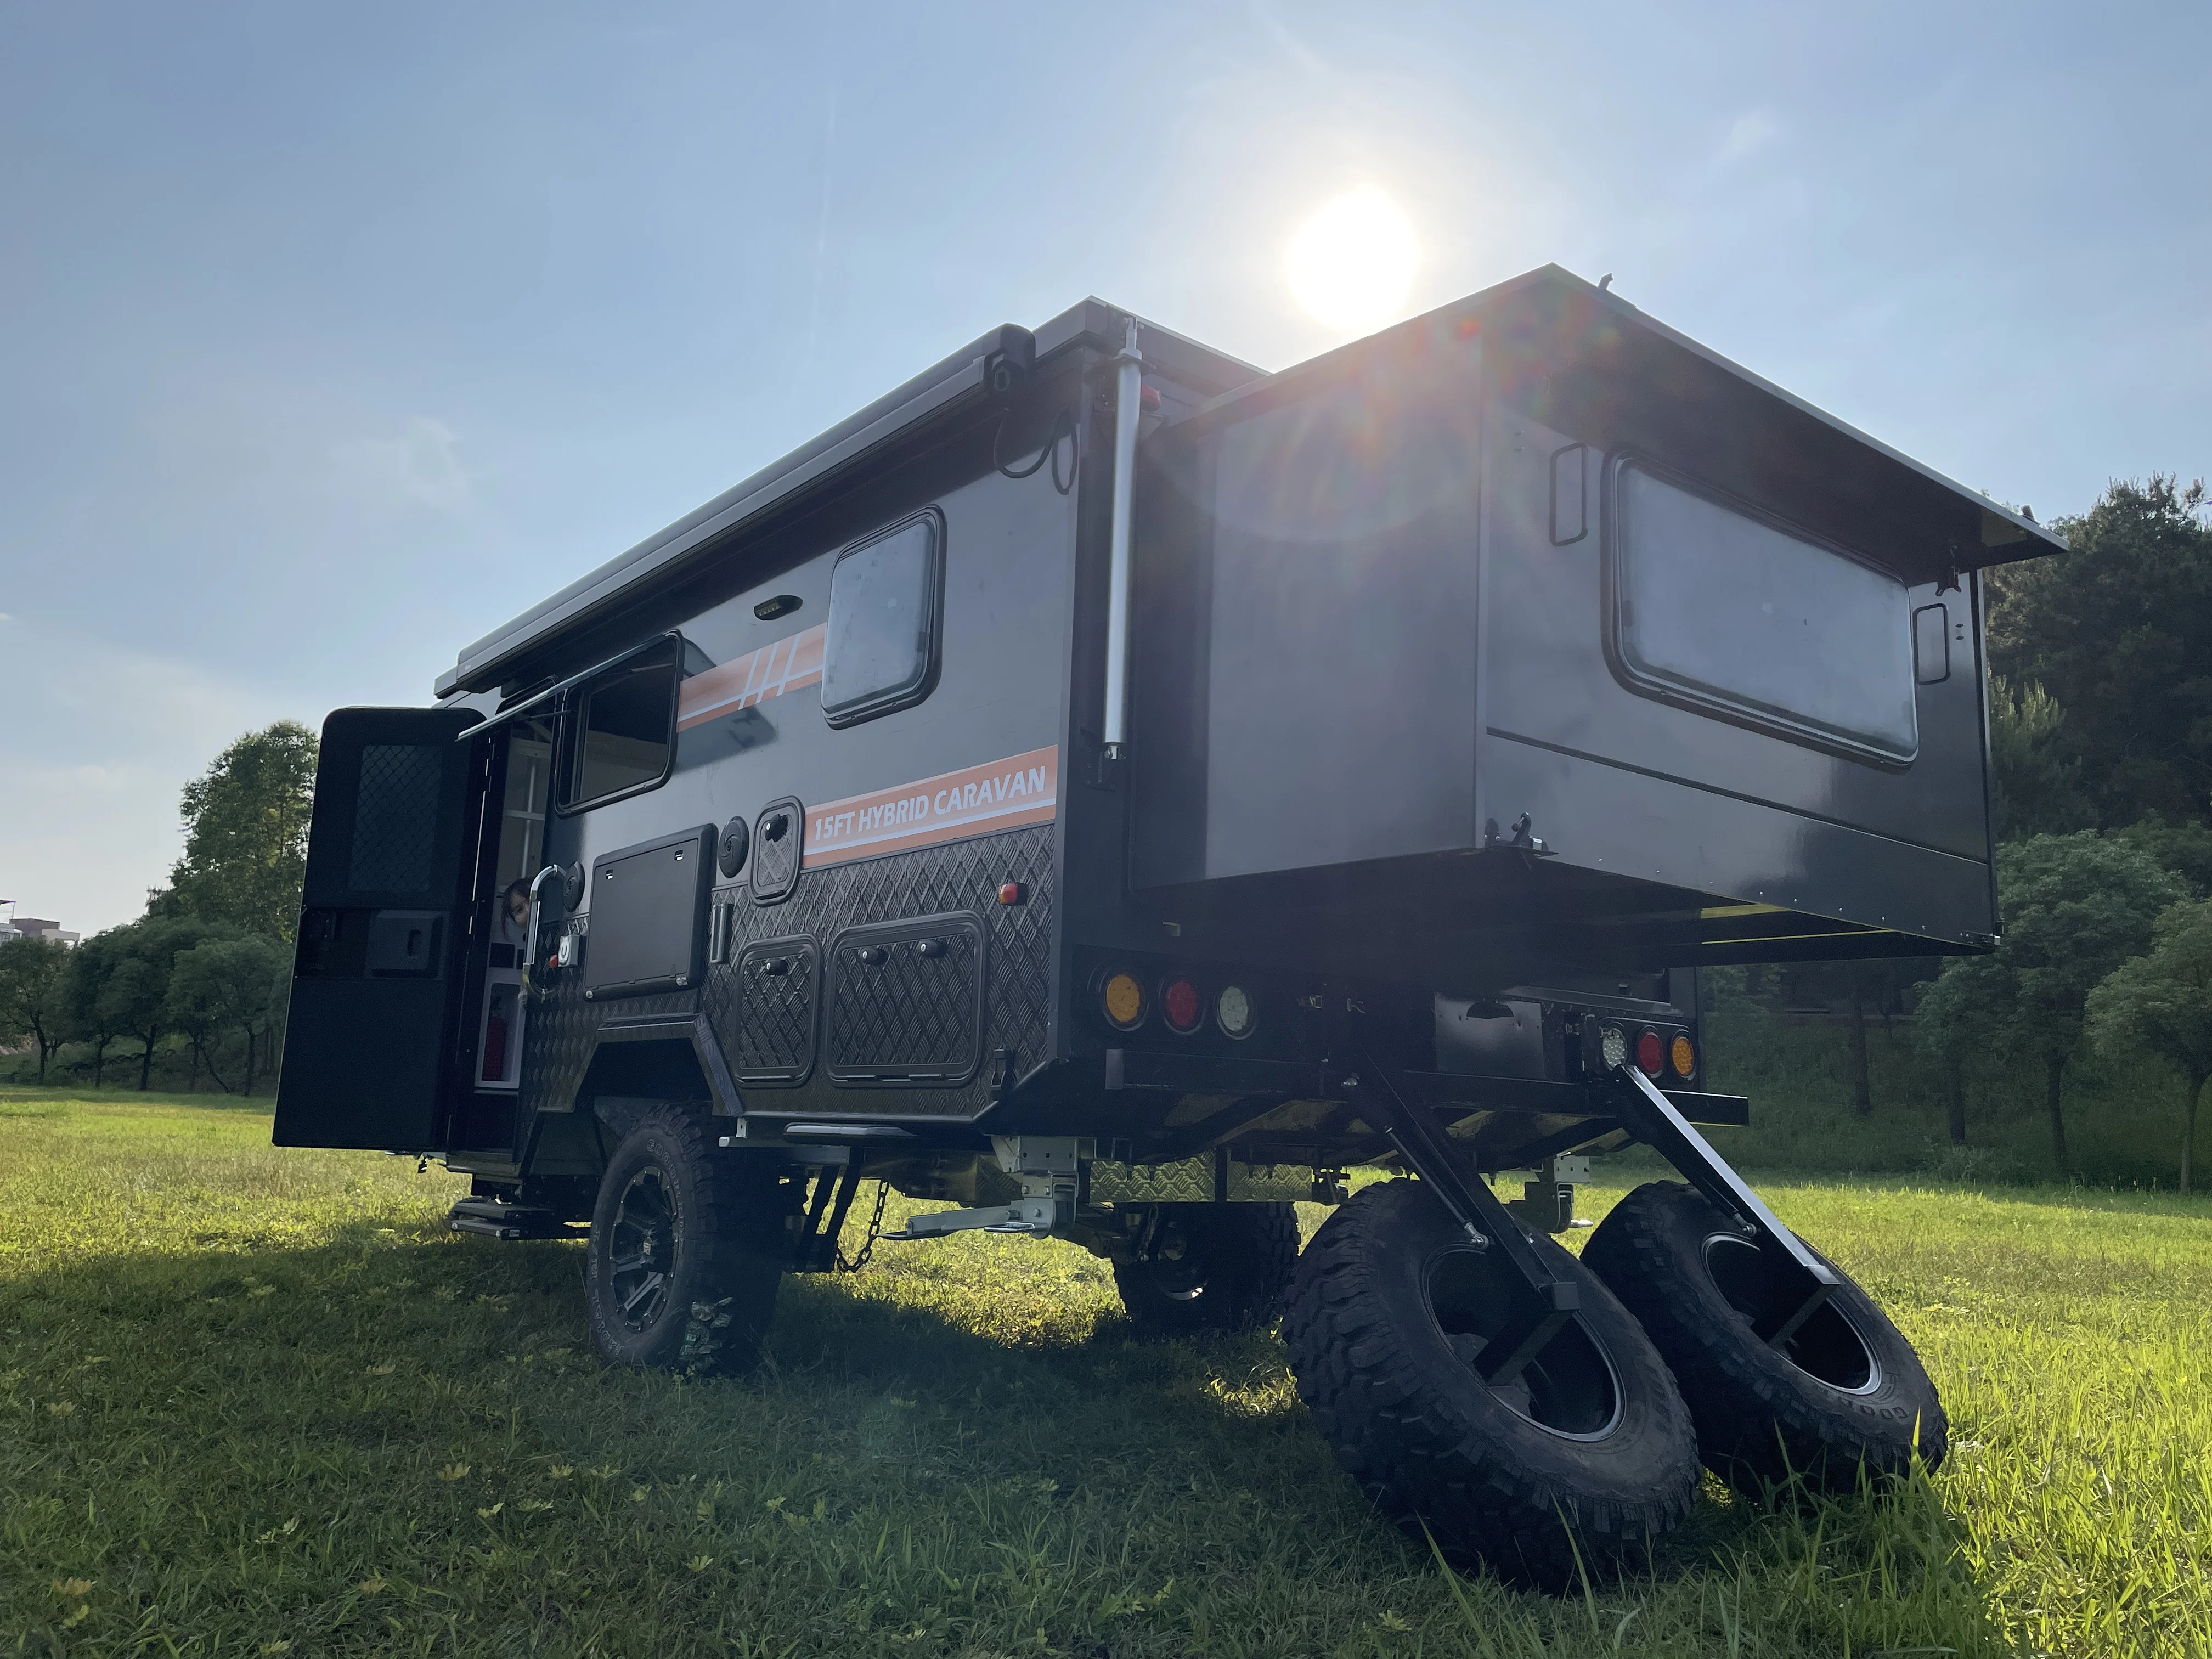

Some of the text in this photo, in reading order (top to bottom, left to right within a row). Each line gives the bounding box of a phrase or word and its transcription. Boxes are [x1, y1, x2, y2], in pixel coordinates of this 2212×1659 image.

[815, 766, 1046, 840] 15FT HYBRID CARAVAN
[592, 1289, 625, 1358] RADIAL
